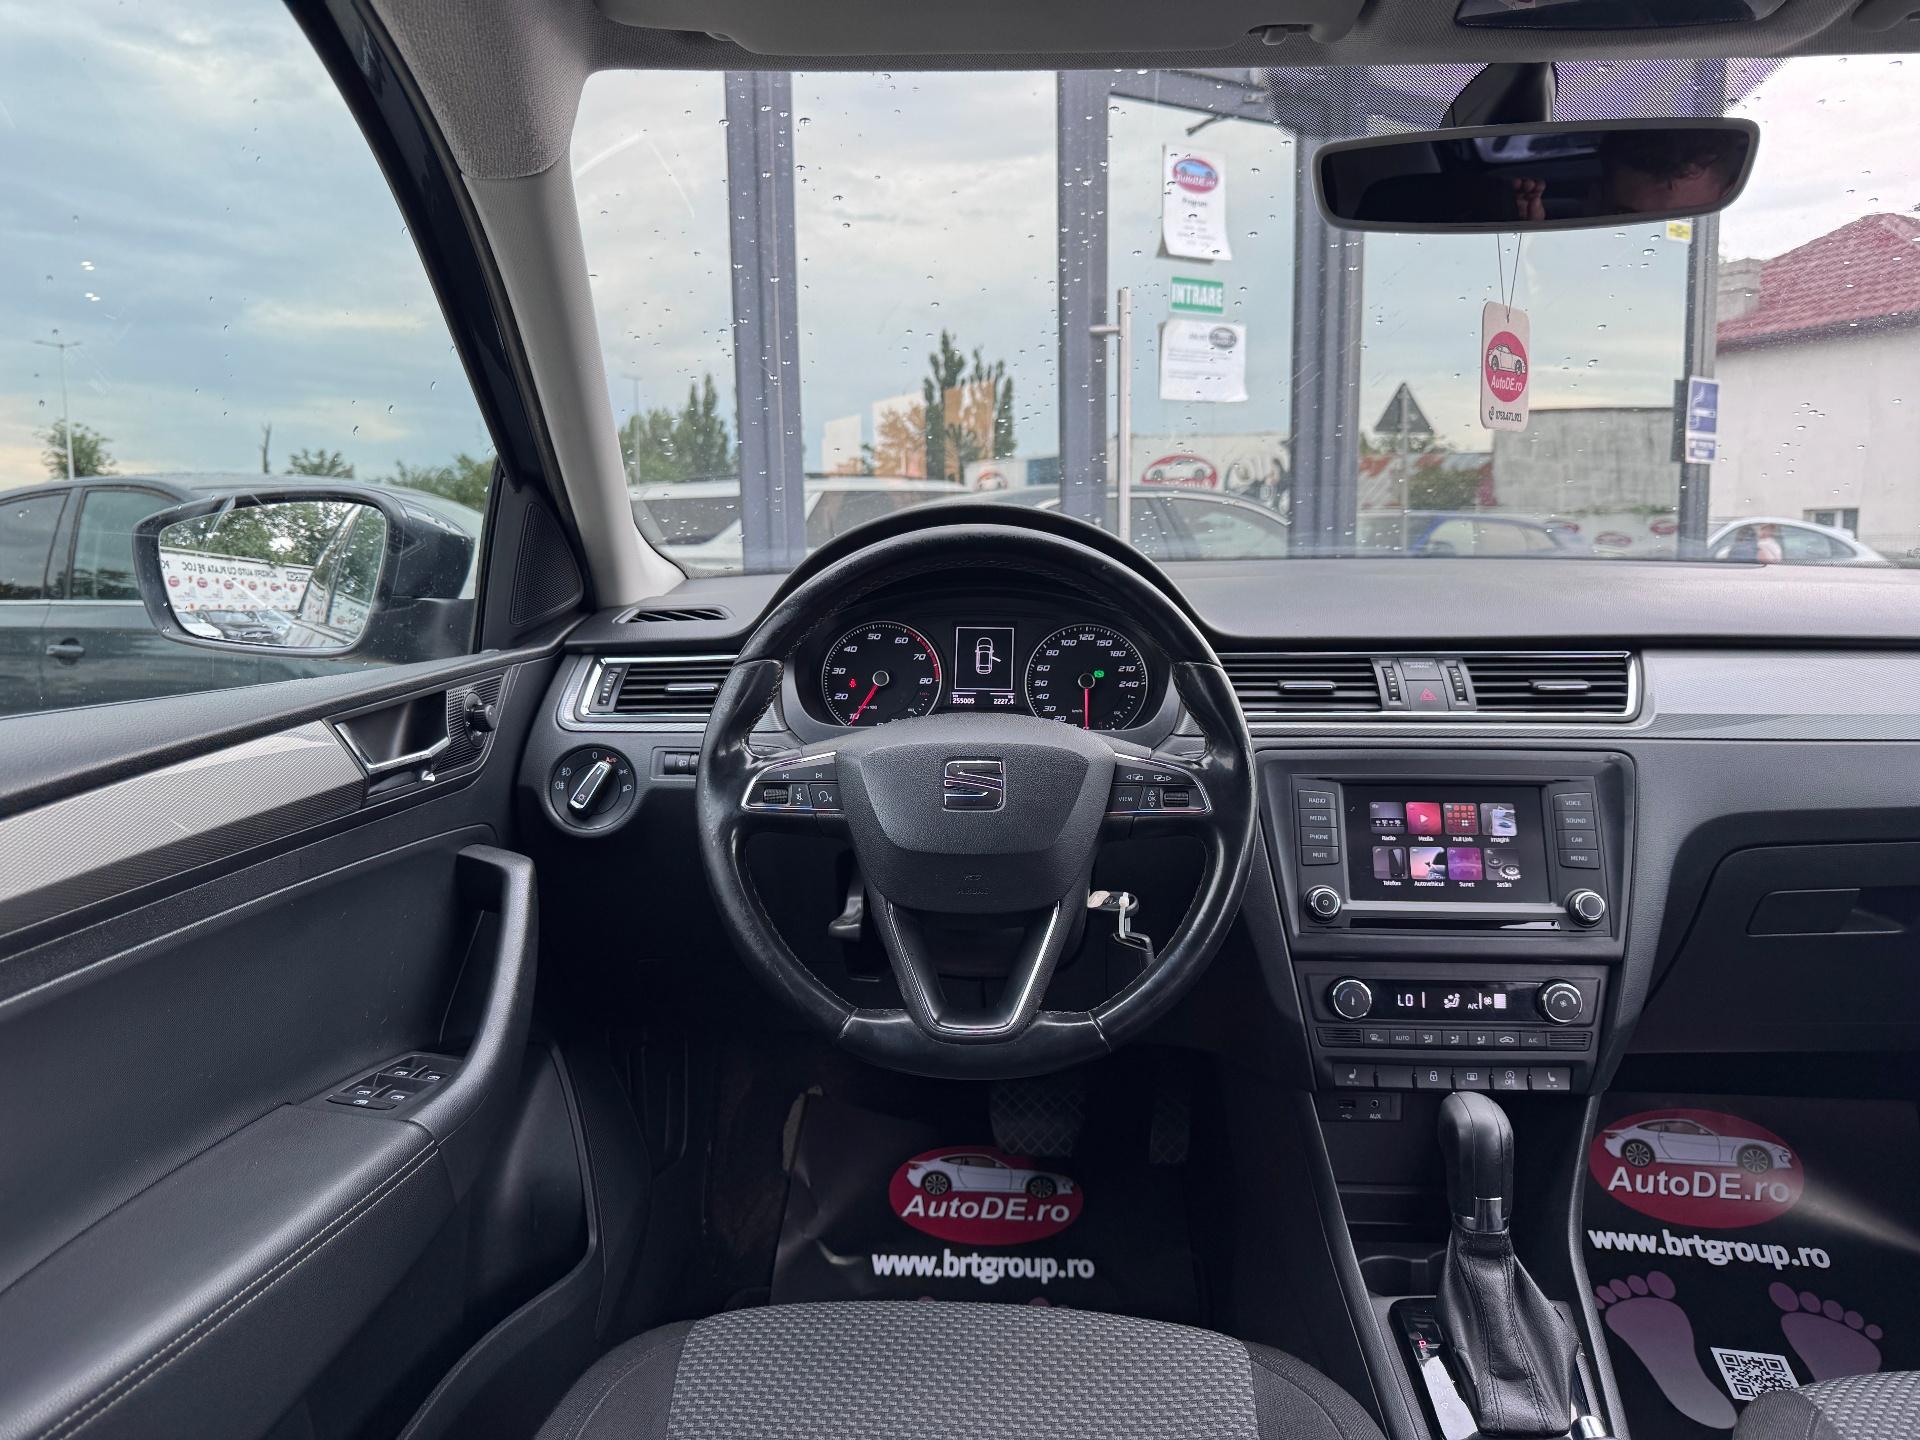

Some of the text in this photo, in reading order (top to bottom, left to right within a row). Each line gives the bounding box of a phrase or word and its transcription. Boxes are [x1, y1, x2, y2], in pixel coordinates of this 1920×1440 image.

[1172, 283, 1223, 308] INTRARE
[1491, 375, 1523, 392] AutoDE.ro
[1397, 993, 1414, 1007] LO
[1608, 1165, 1790, 1203] AutoDE.ro
[901, 1195, 1070, 1222] AutoDE.ro
[1587, 1228, 1831, 1271] www.brtgroup.ro
[871, 1248, 1095, 1285] www.brtgroup.ro
[1418, 1340, 1427, 1348] P
